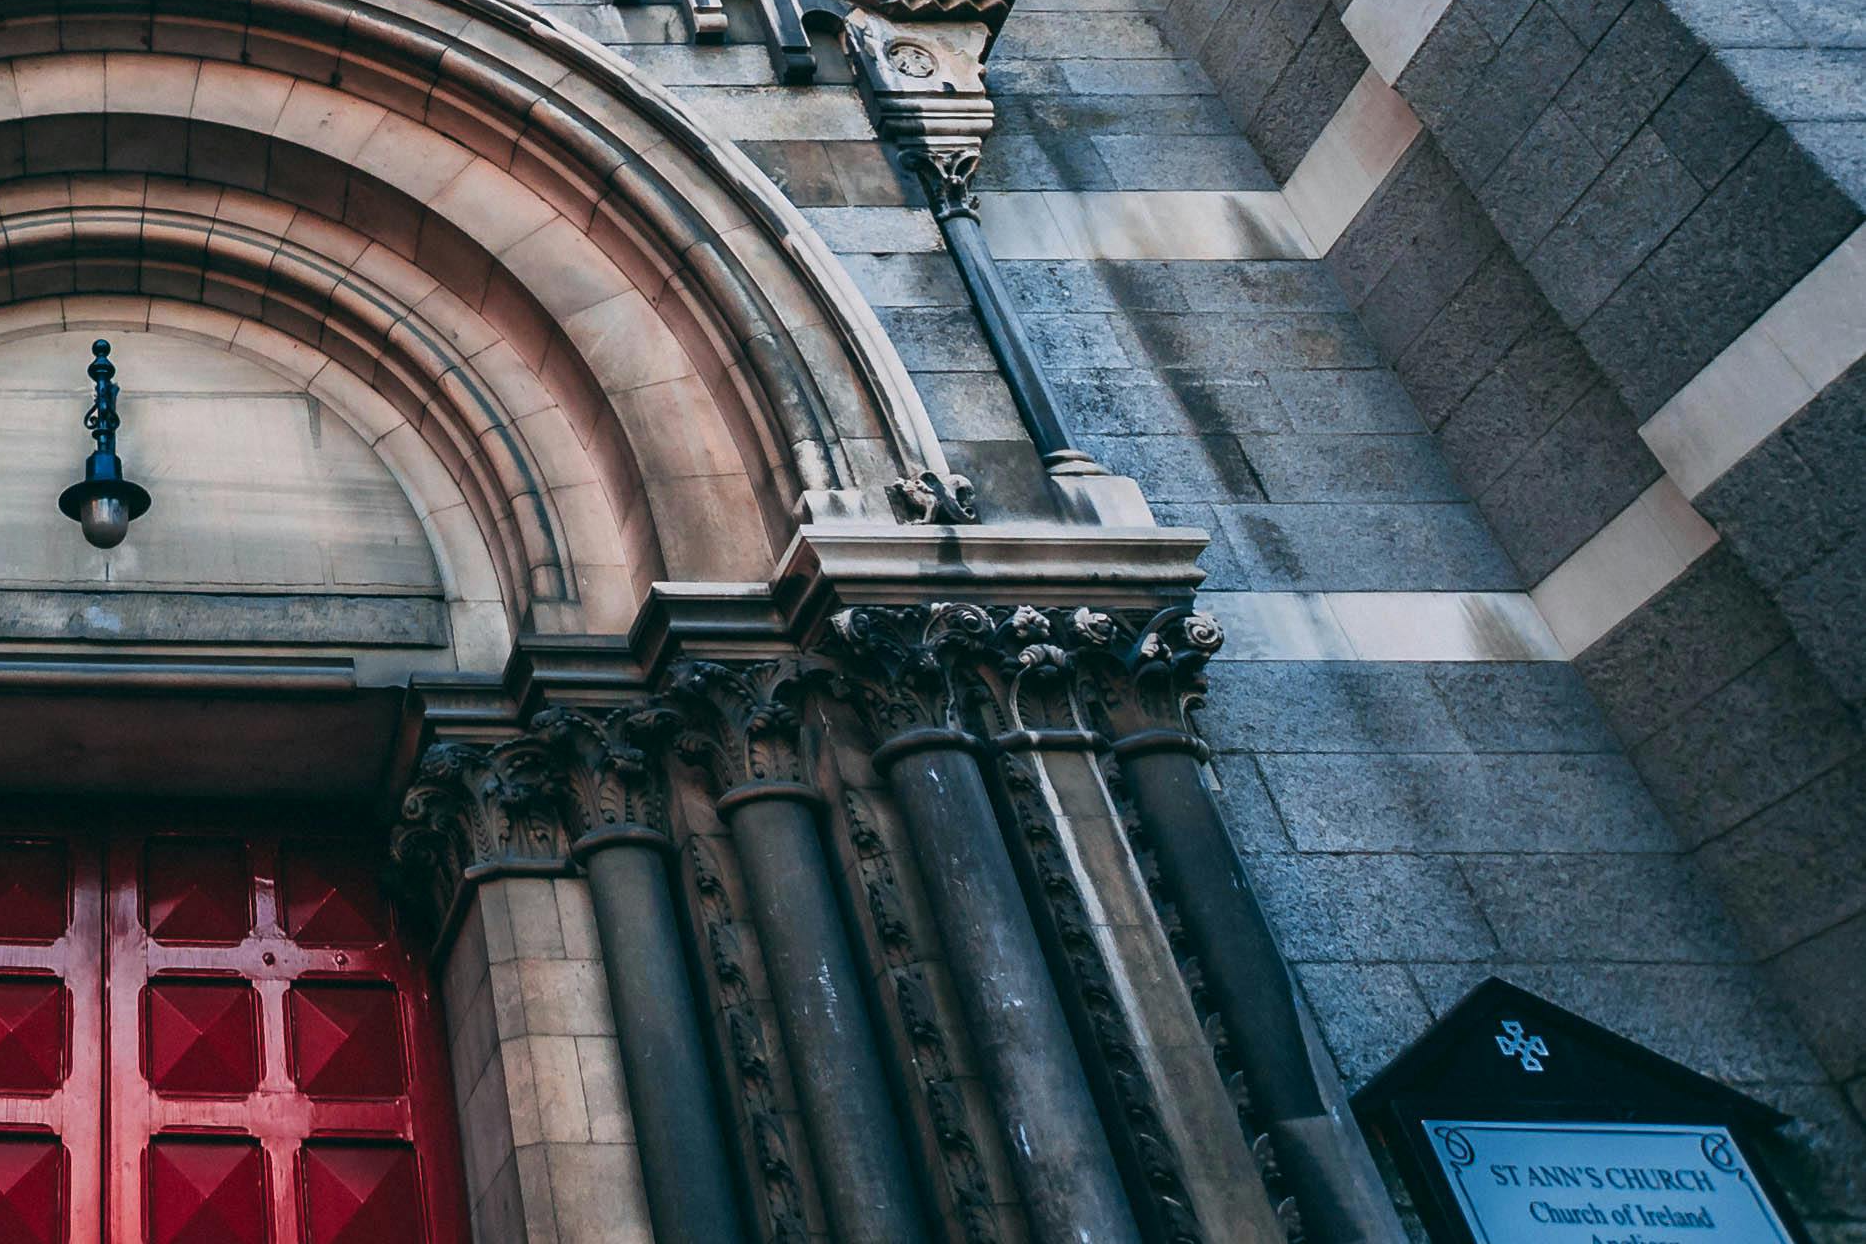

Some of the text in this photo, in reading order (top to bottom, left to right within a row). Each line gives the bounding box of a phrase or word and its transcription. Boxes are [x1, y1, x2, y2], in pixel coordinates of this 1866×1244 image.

[1490, 1164, 1716, 1192] ST ANN'S CHURCH
[1529, 1201, 1716, 1229] Church of Ireland
